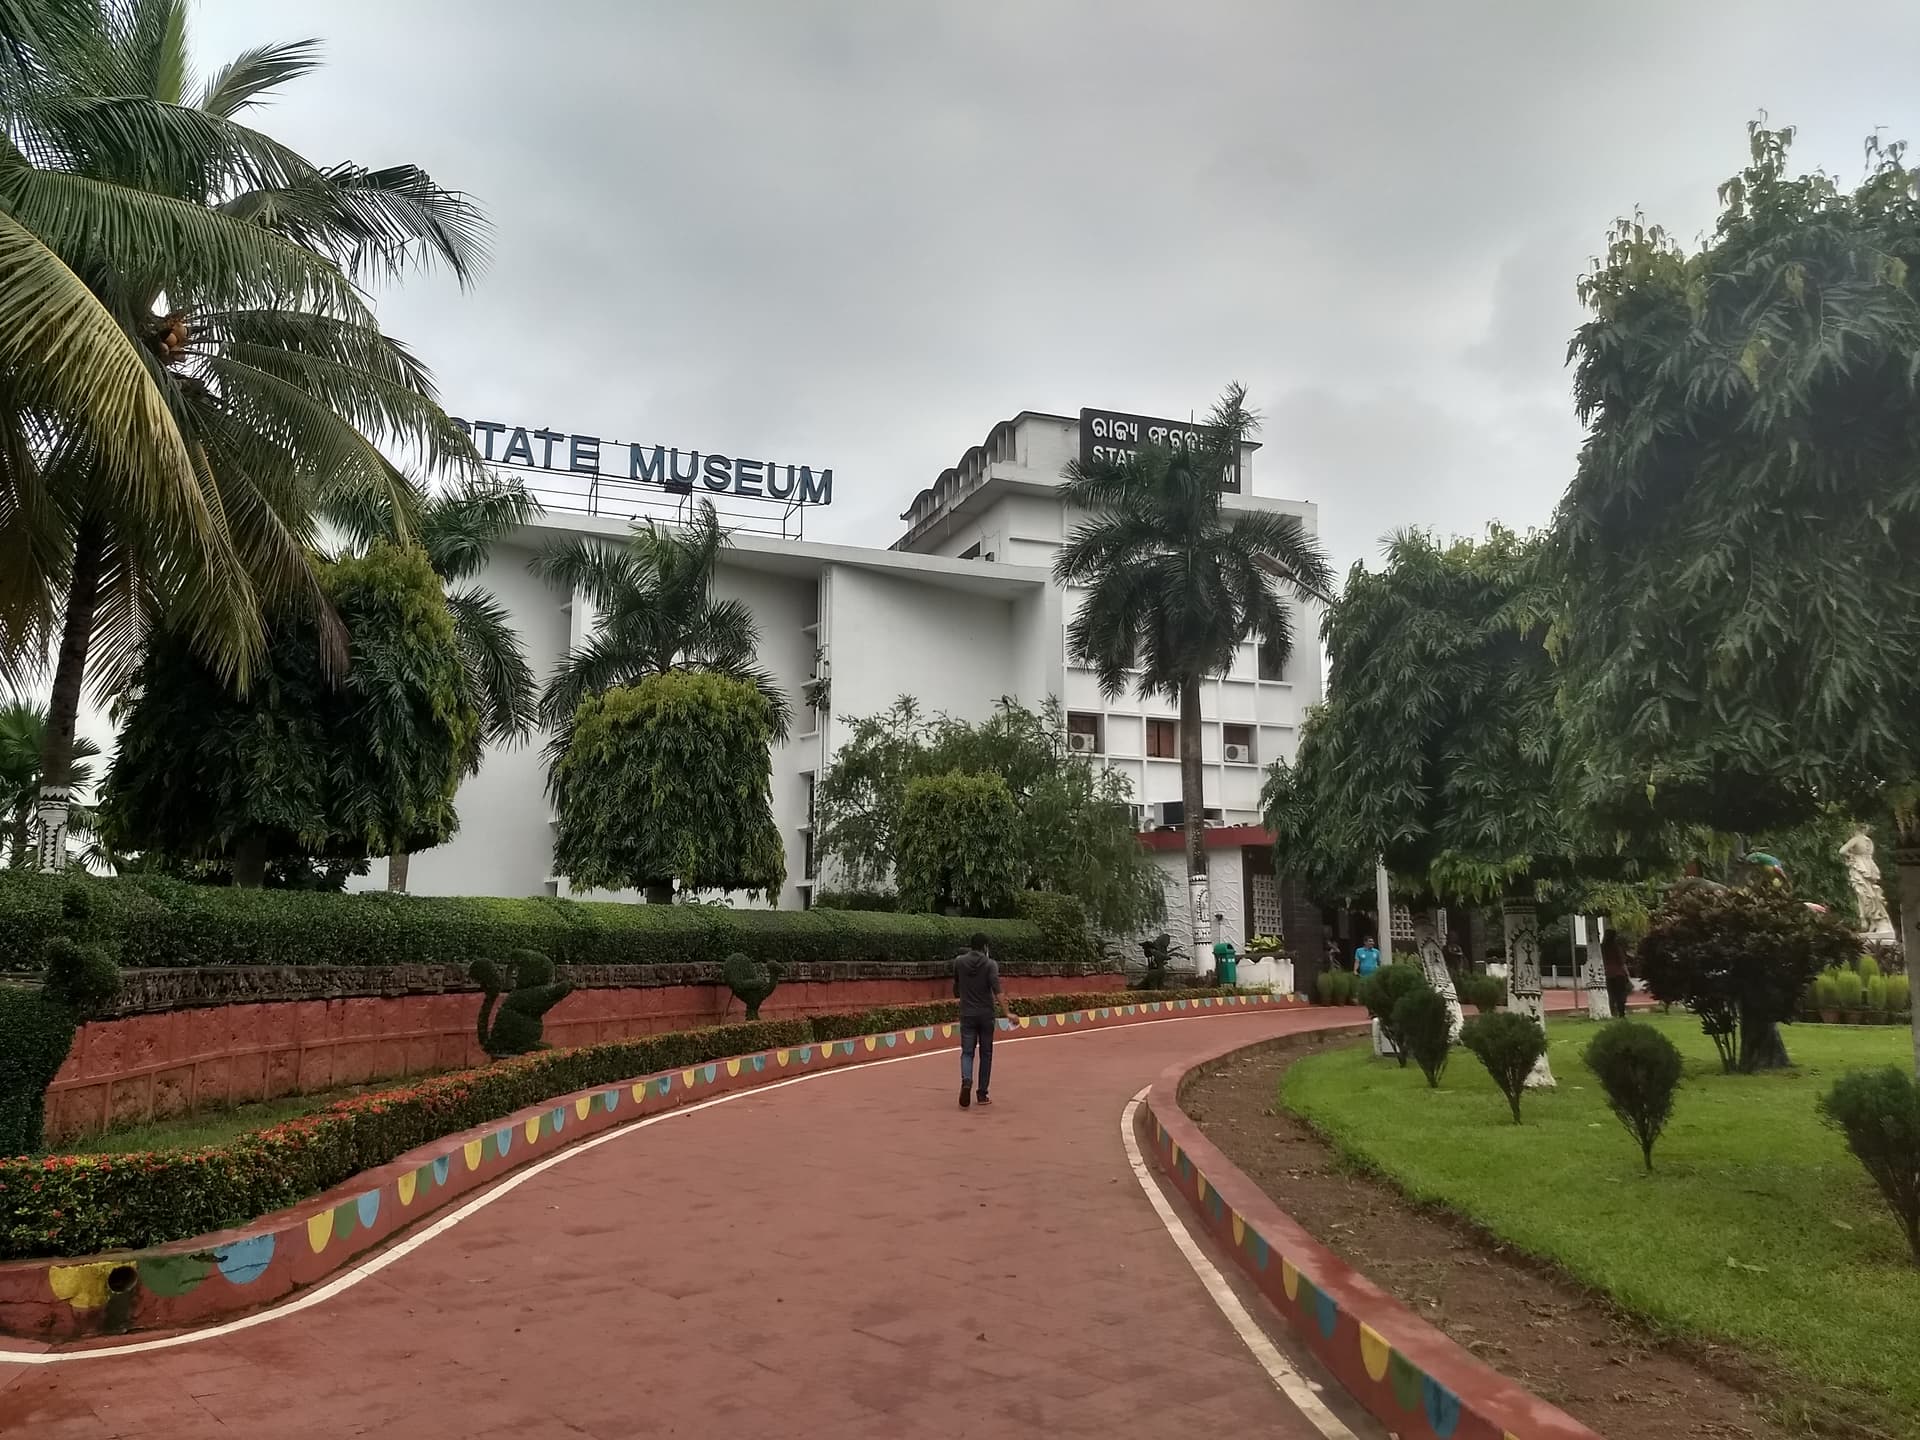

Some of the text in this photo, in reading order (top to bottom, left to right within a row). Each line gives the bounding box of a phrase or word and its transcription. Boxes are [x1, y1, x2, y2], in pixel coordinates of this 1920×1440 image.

[1091, 417, 1138, 442] ରାଜ୍ୟ
[1092, 445, 1143, 468] STAT
[629, 442, 833, 505] MUSEUM
